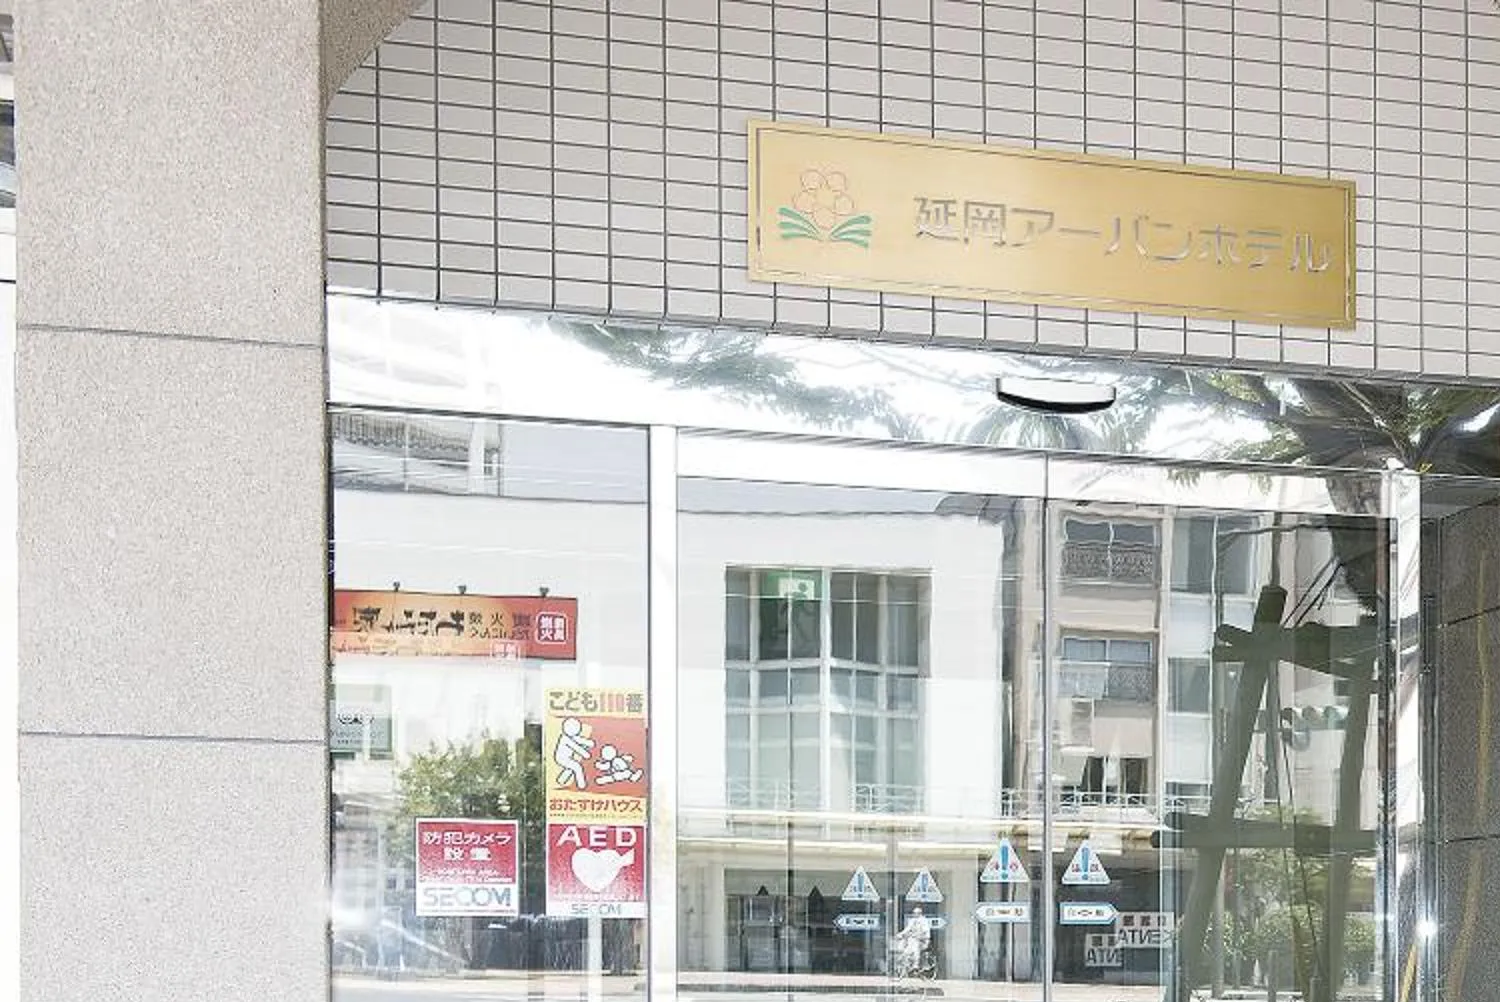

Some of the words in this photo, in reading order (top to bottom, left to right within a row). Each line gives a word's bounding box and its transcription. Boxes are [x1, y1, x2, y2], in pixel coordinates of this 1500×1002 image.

[913, 196, 1333, 273] 延岡アーバンホテル
[549, 798, 643, 812] おたすけハウス
[423, 831, 512, 845] 防犯カメラ
[556, 826, 637, 846] AED
[423, 886, 511, 907] SECOM
[571, 903, 622, 915] SECOM
